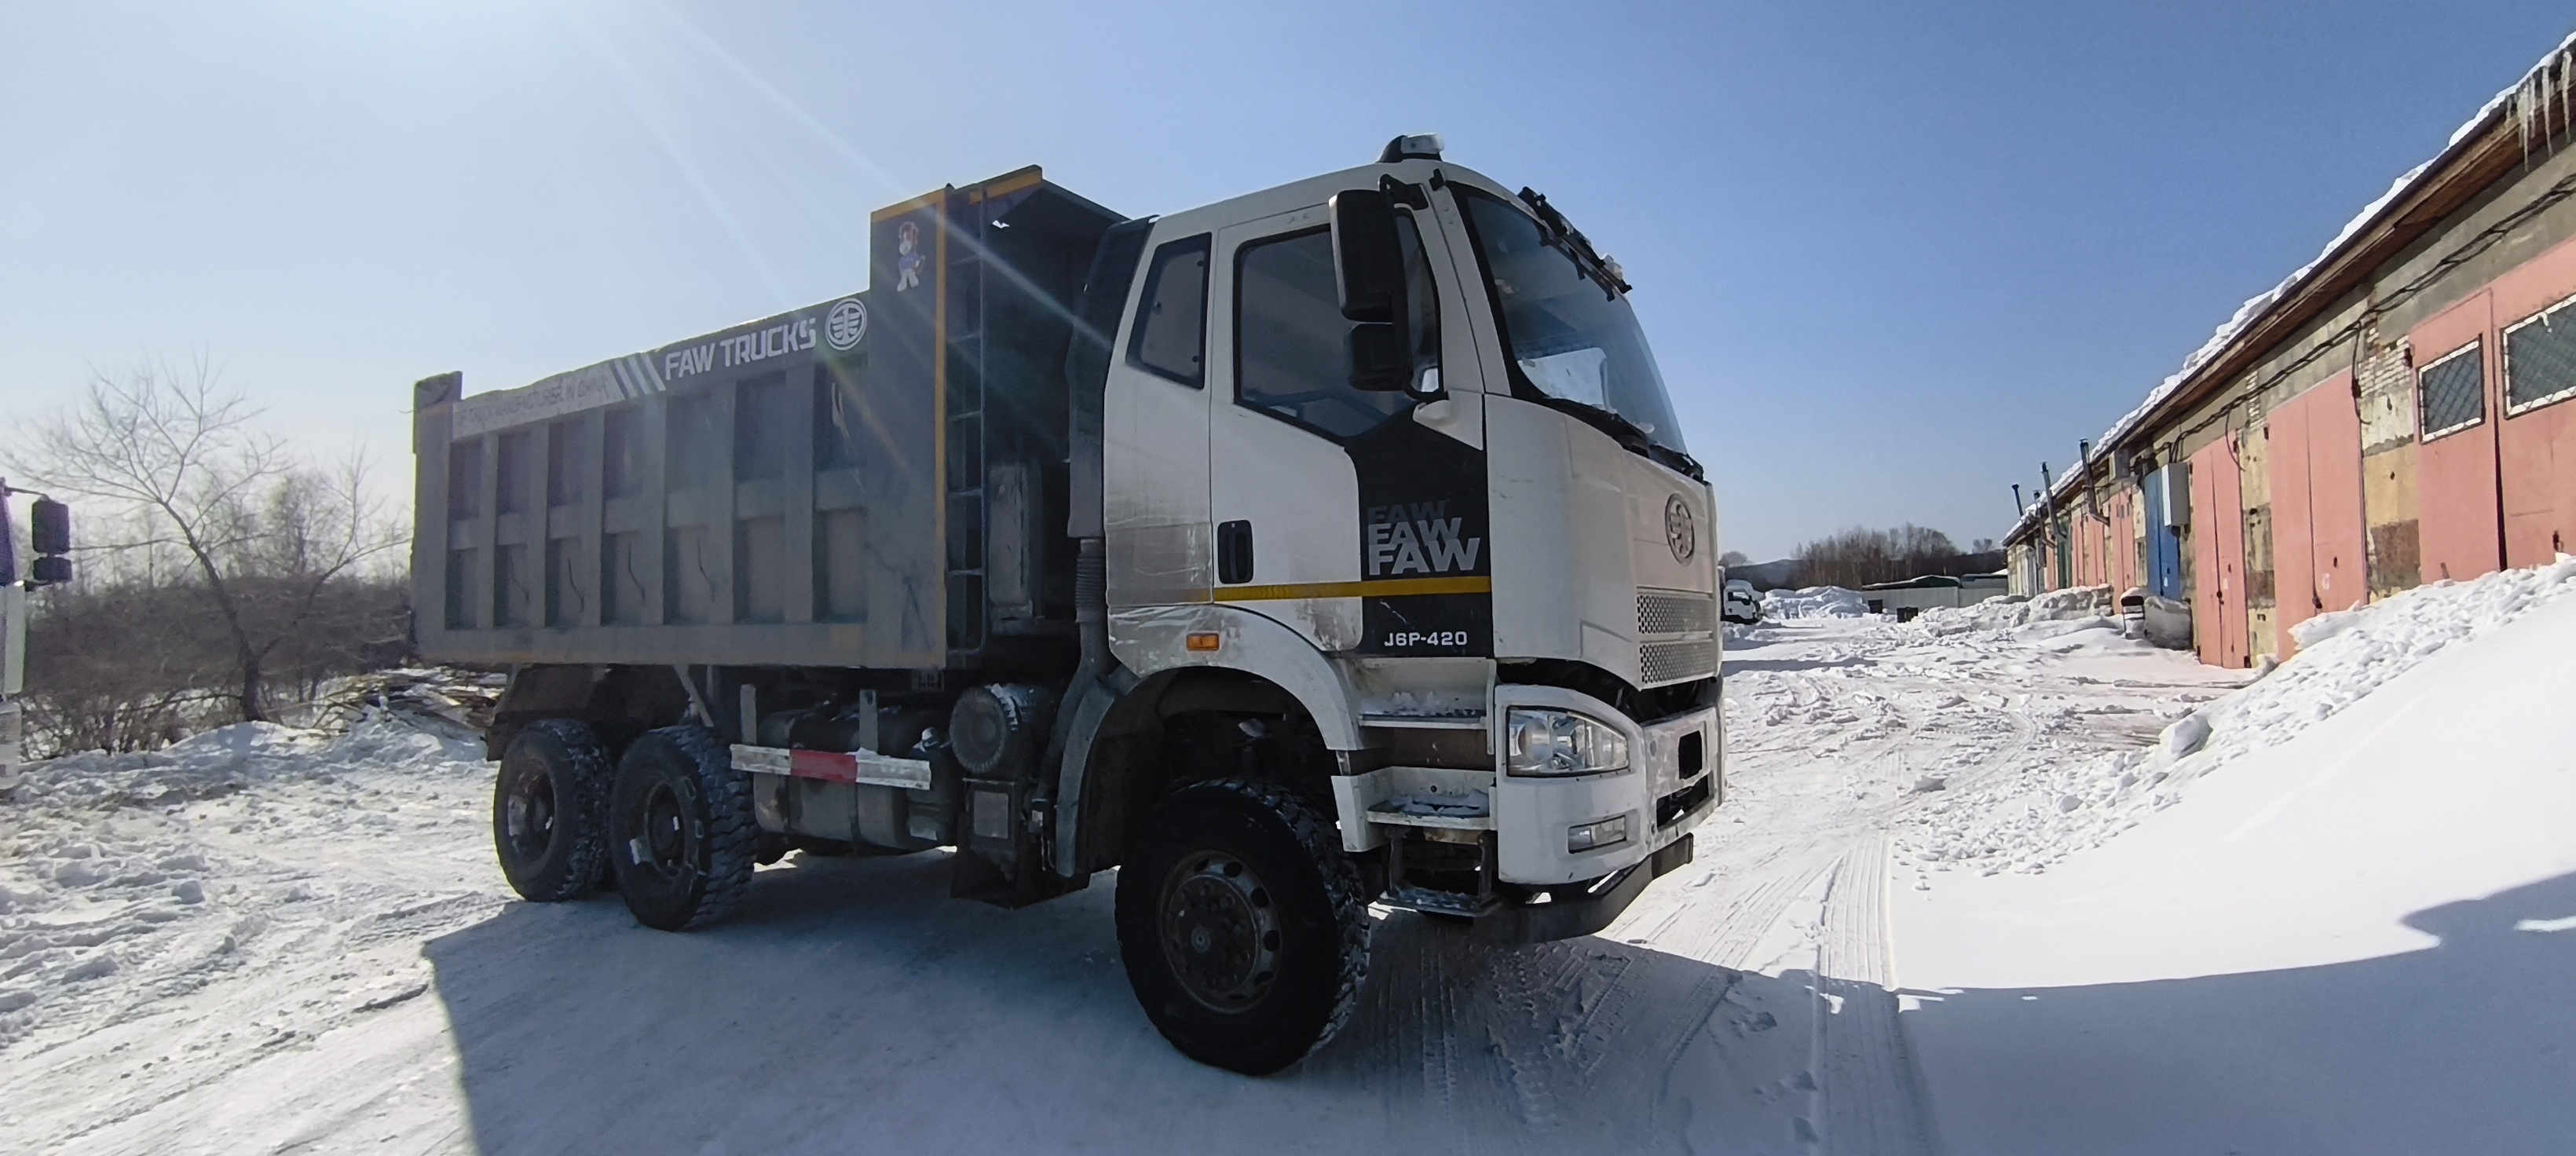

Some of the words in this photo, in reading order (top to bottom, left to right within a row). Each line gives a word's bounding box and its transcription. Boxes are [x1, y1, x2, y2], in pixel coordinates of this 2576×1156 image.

[665, 342, 715, 381] FAW
[719, 318, 817, 368] TRUCKS
[1367, 499, 1447, 525] FAW
[1368, 517, 1462, 547] FAW
[1368, 537, 1480, 576] FAW
[1384, 631, 1468, 647] J6P-420
